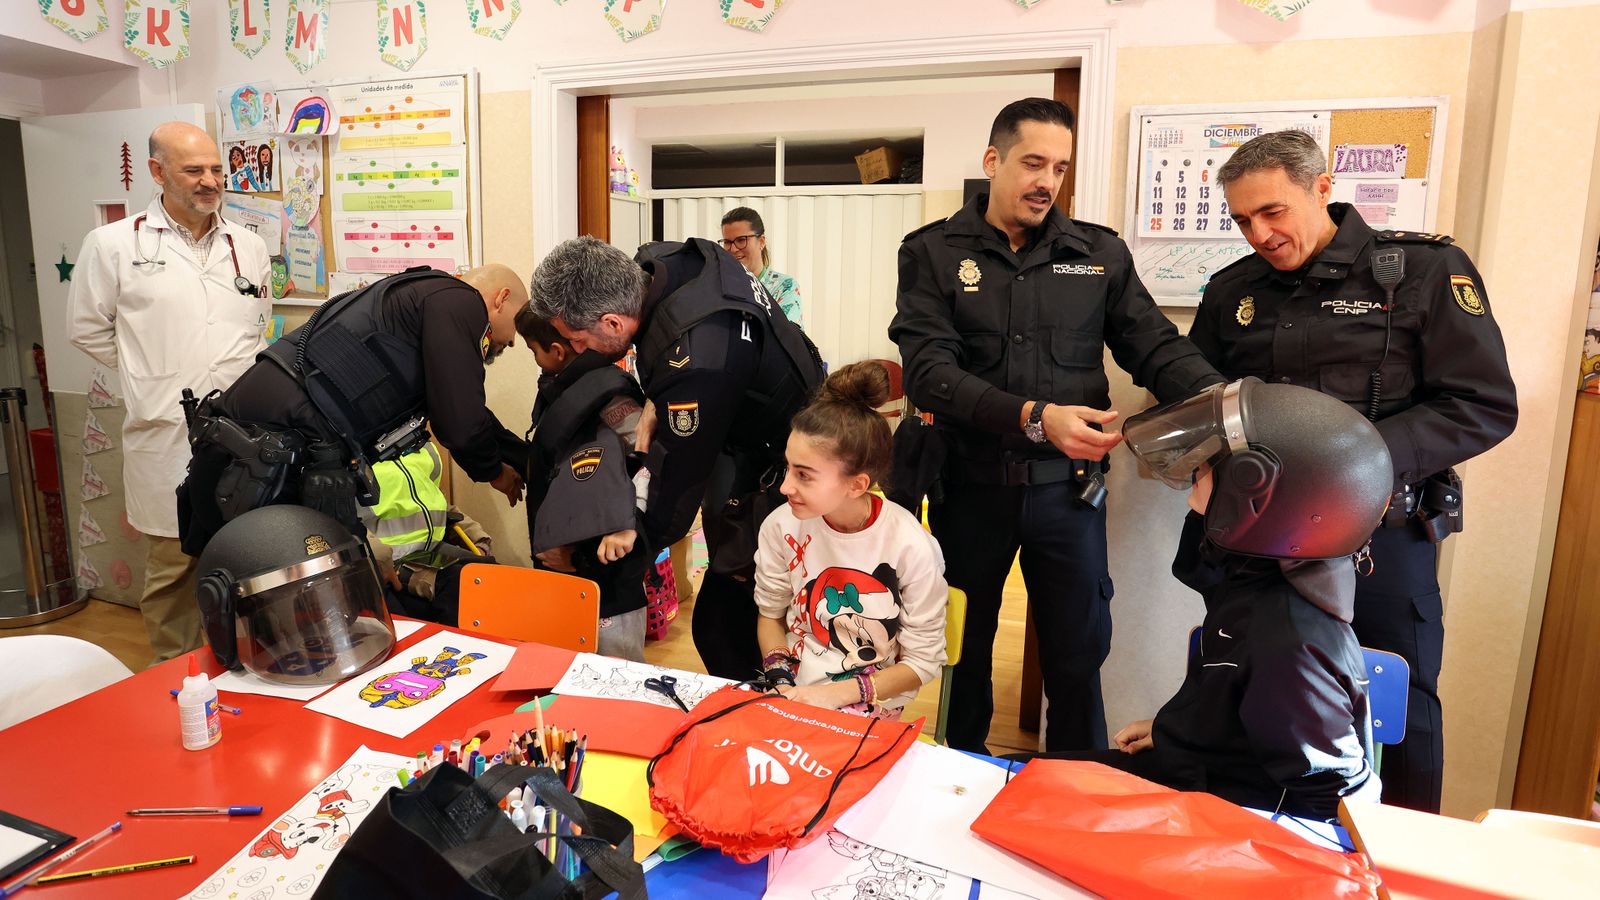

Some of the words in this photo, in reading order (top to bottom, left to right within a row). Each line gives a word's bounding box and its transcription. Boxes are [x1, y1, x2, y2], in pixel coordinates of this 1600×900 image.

[146, 8, 170, 46] K
[243, 0, 257, 36] L
[295, 11, 318, 51] M
[392, 4, 414, 47] N
[361, 85, 386, 93] Unidades
[1203, 128, 1263, 138] DICIEMBRE
[1334, 149, 1395, 173] LAURA
[1155, 170, 1162, 183] 4
[1178, 170, 1185, 183] 5
[1201, 169, 1208, 182] 6
[1153, 186, 1163, 199] 11
[1176, 186, 1187, 199] 12
[1199, 186, 1210, 199] 13
[1152, 202, 1163, 215] 18
[1175, 202, 1186, 215] 19
[1197, 202, 1210, 215] 20
[1150, 218, 1162, 231] 25
[1173, 218, 1185, 231] 26
[1196, 218, 1208, 231] 27
[1220, 218, 1232, 231] 28
[1333, 307, 1368, 315] CNP
